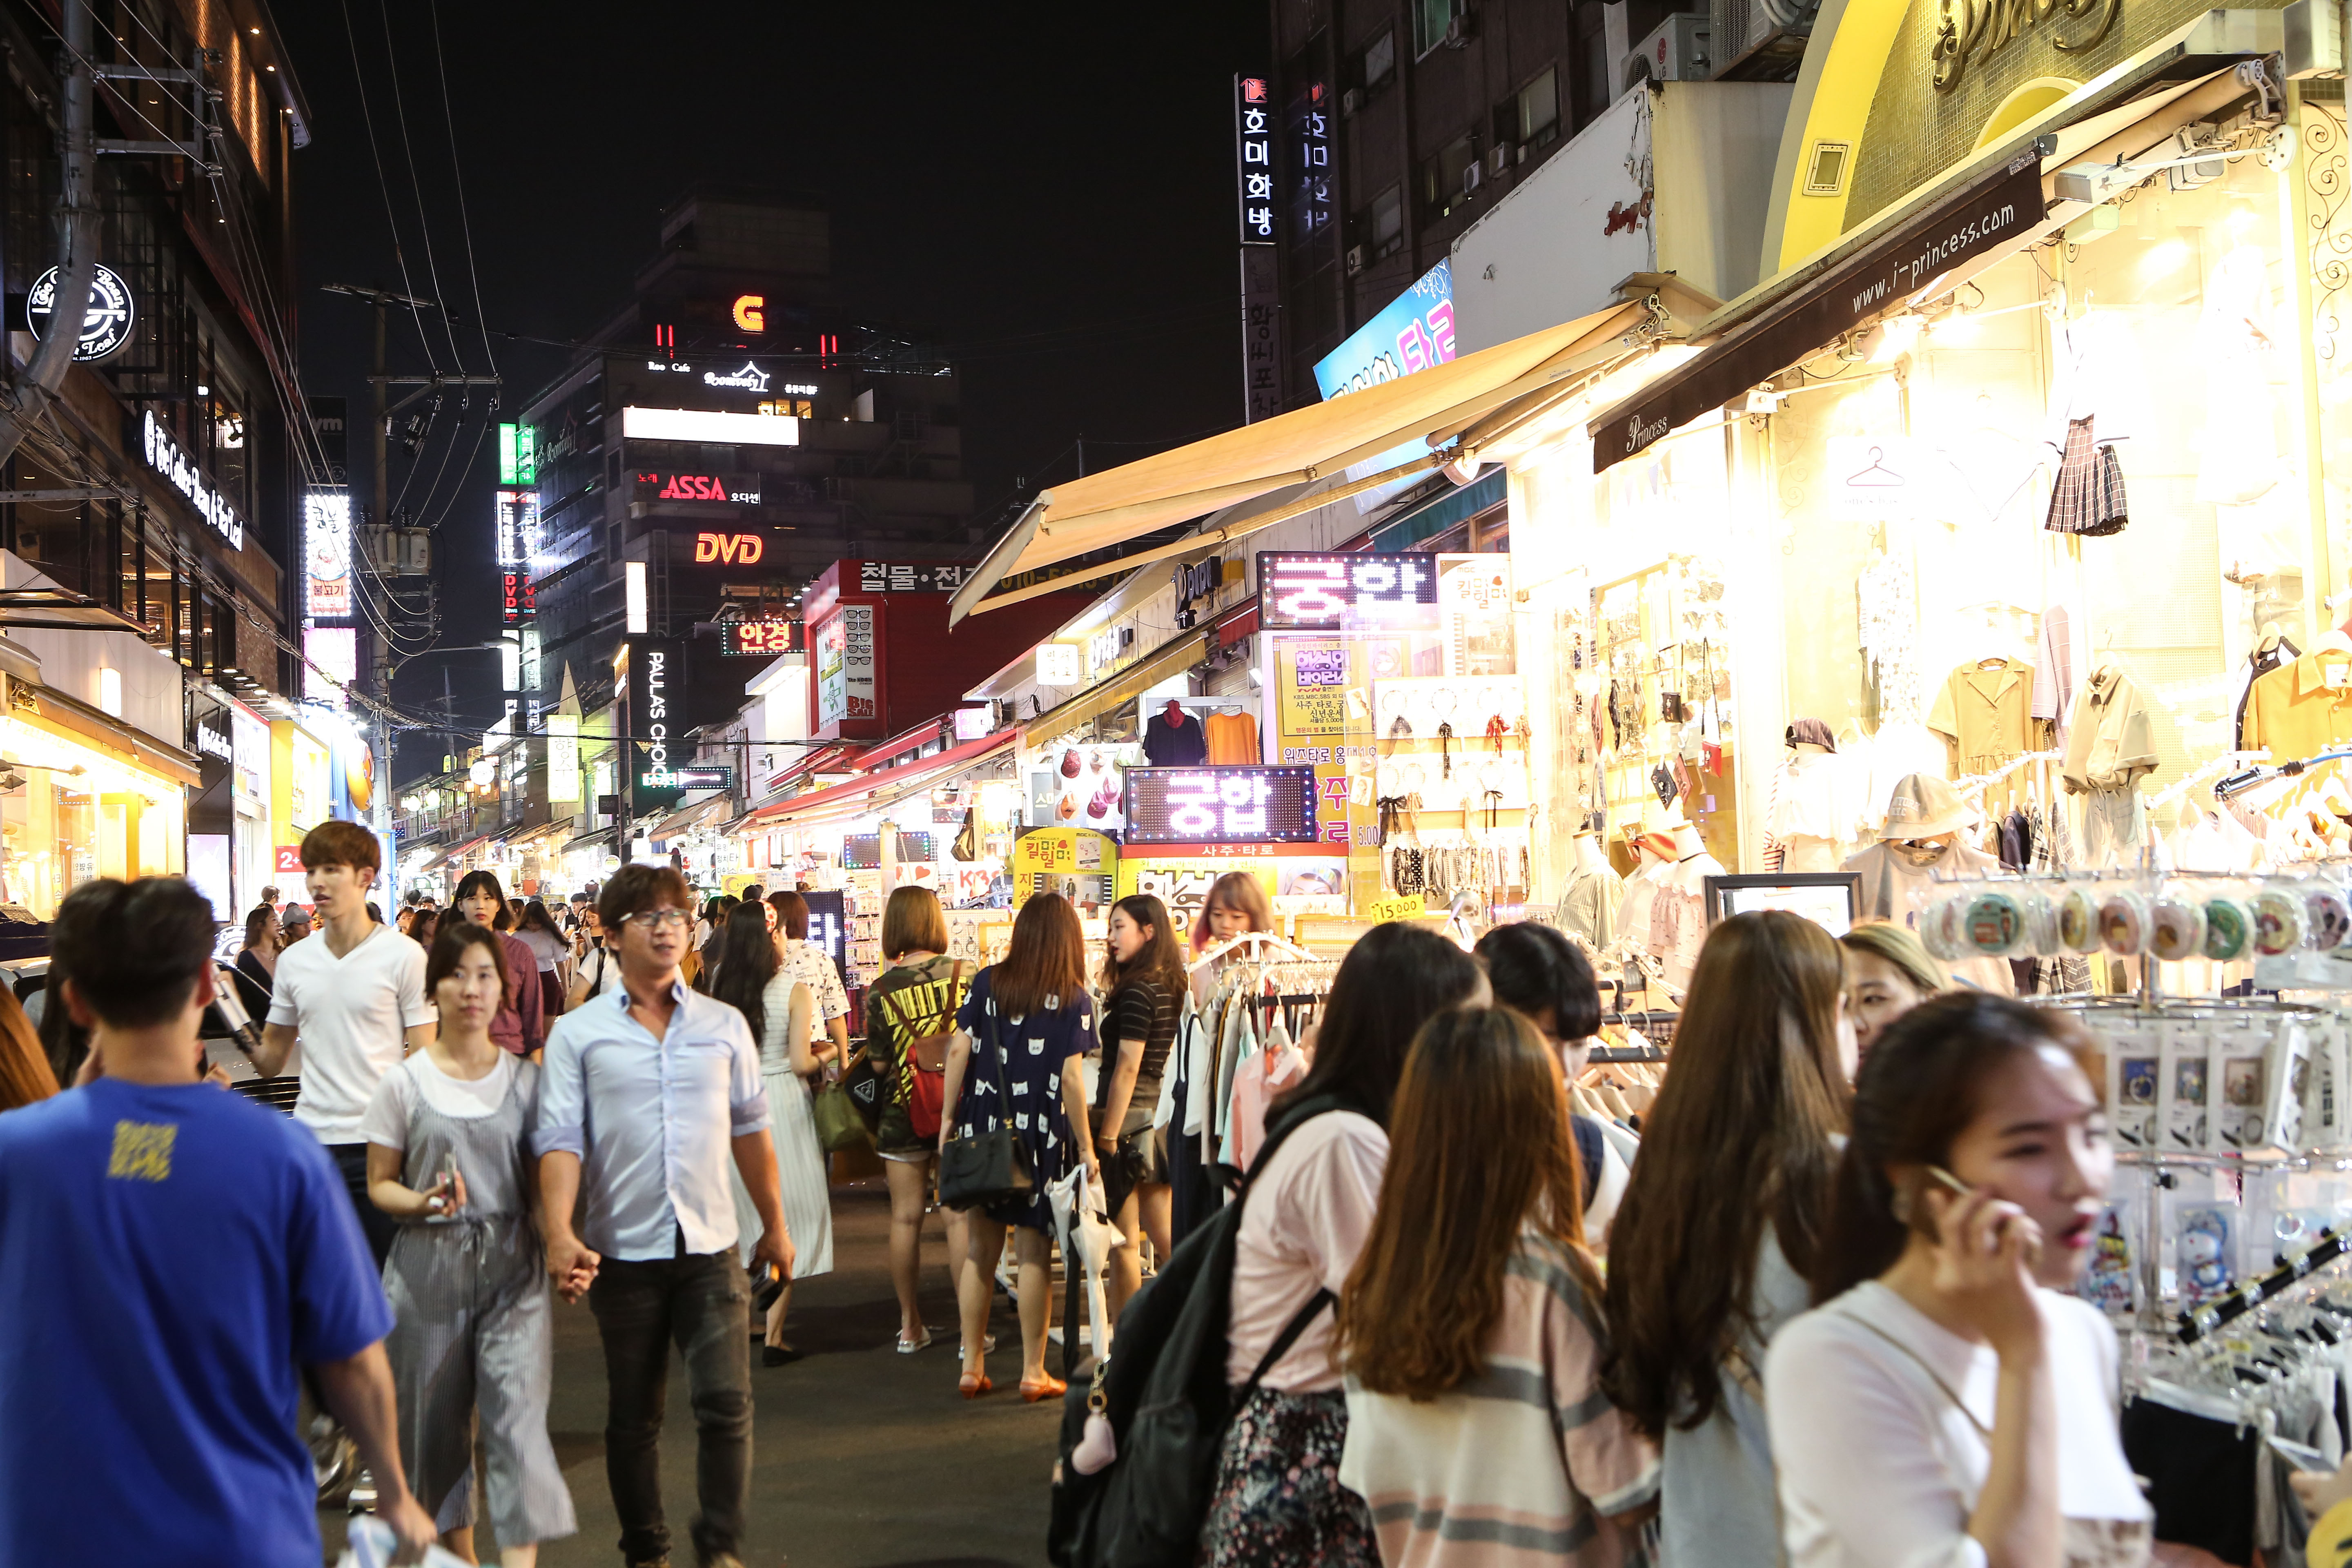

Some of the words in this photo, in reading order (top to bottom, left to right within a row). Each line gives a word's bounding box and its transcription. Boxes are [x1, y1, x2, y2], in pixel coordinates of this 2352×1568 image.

[1243, 108, 1273, 235] 호미화방
[1853, 204, 2014, 314] www.i-princess.com
[96, 269, 125, 309] Bean
[82, 327, 117, 354] Leaf
[671, 363, 691, 372] Cafe
[1626, 414, 1667, 452] Princess
[638, 473, 658, 483] 노래
[662, 474, 727, 501] ASSA
[730, 492, 759, 504] 오디션
[695, 532, 762, 566] DVD
[313, 585, 344, 596] 불고기
[504, 575, 517, 608] DVD
[861, 562, 982, 591] 철물·전
[1274, 562, 1425, 618] 궁합
[739, 624, 790, 651] 안경
[648, 652, 666, 719] PAULA'S
[848, 708, 874, 717] SALE
[1310, 709, 1344, 718] 신년운세
[554, 738, 573, 777] 향수
[650, 723, 668, 774] CHOIC
[1166, 776, 1273, 833] 궁합
[1202, 845, 1275, 856] 사주·타로
